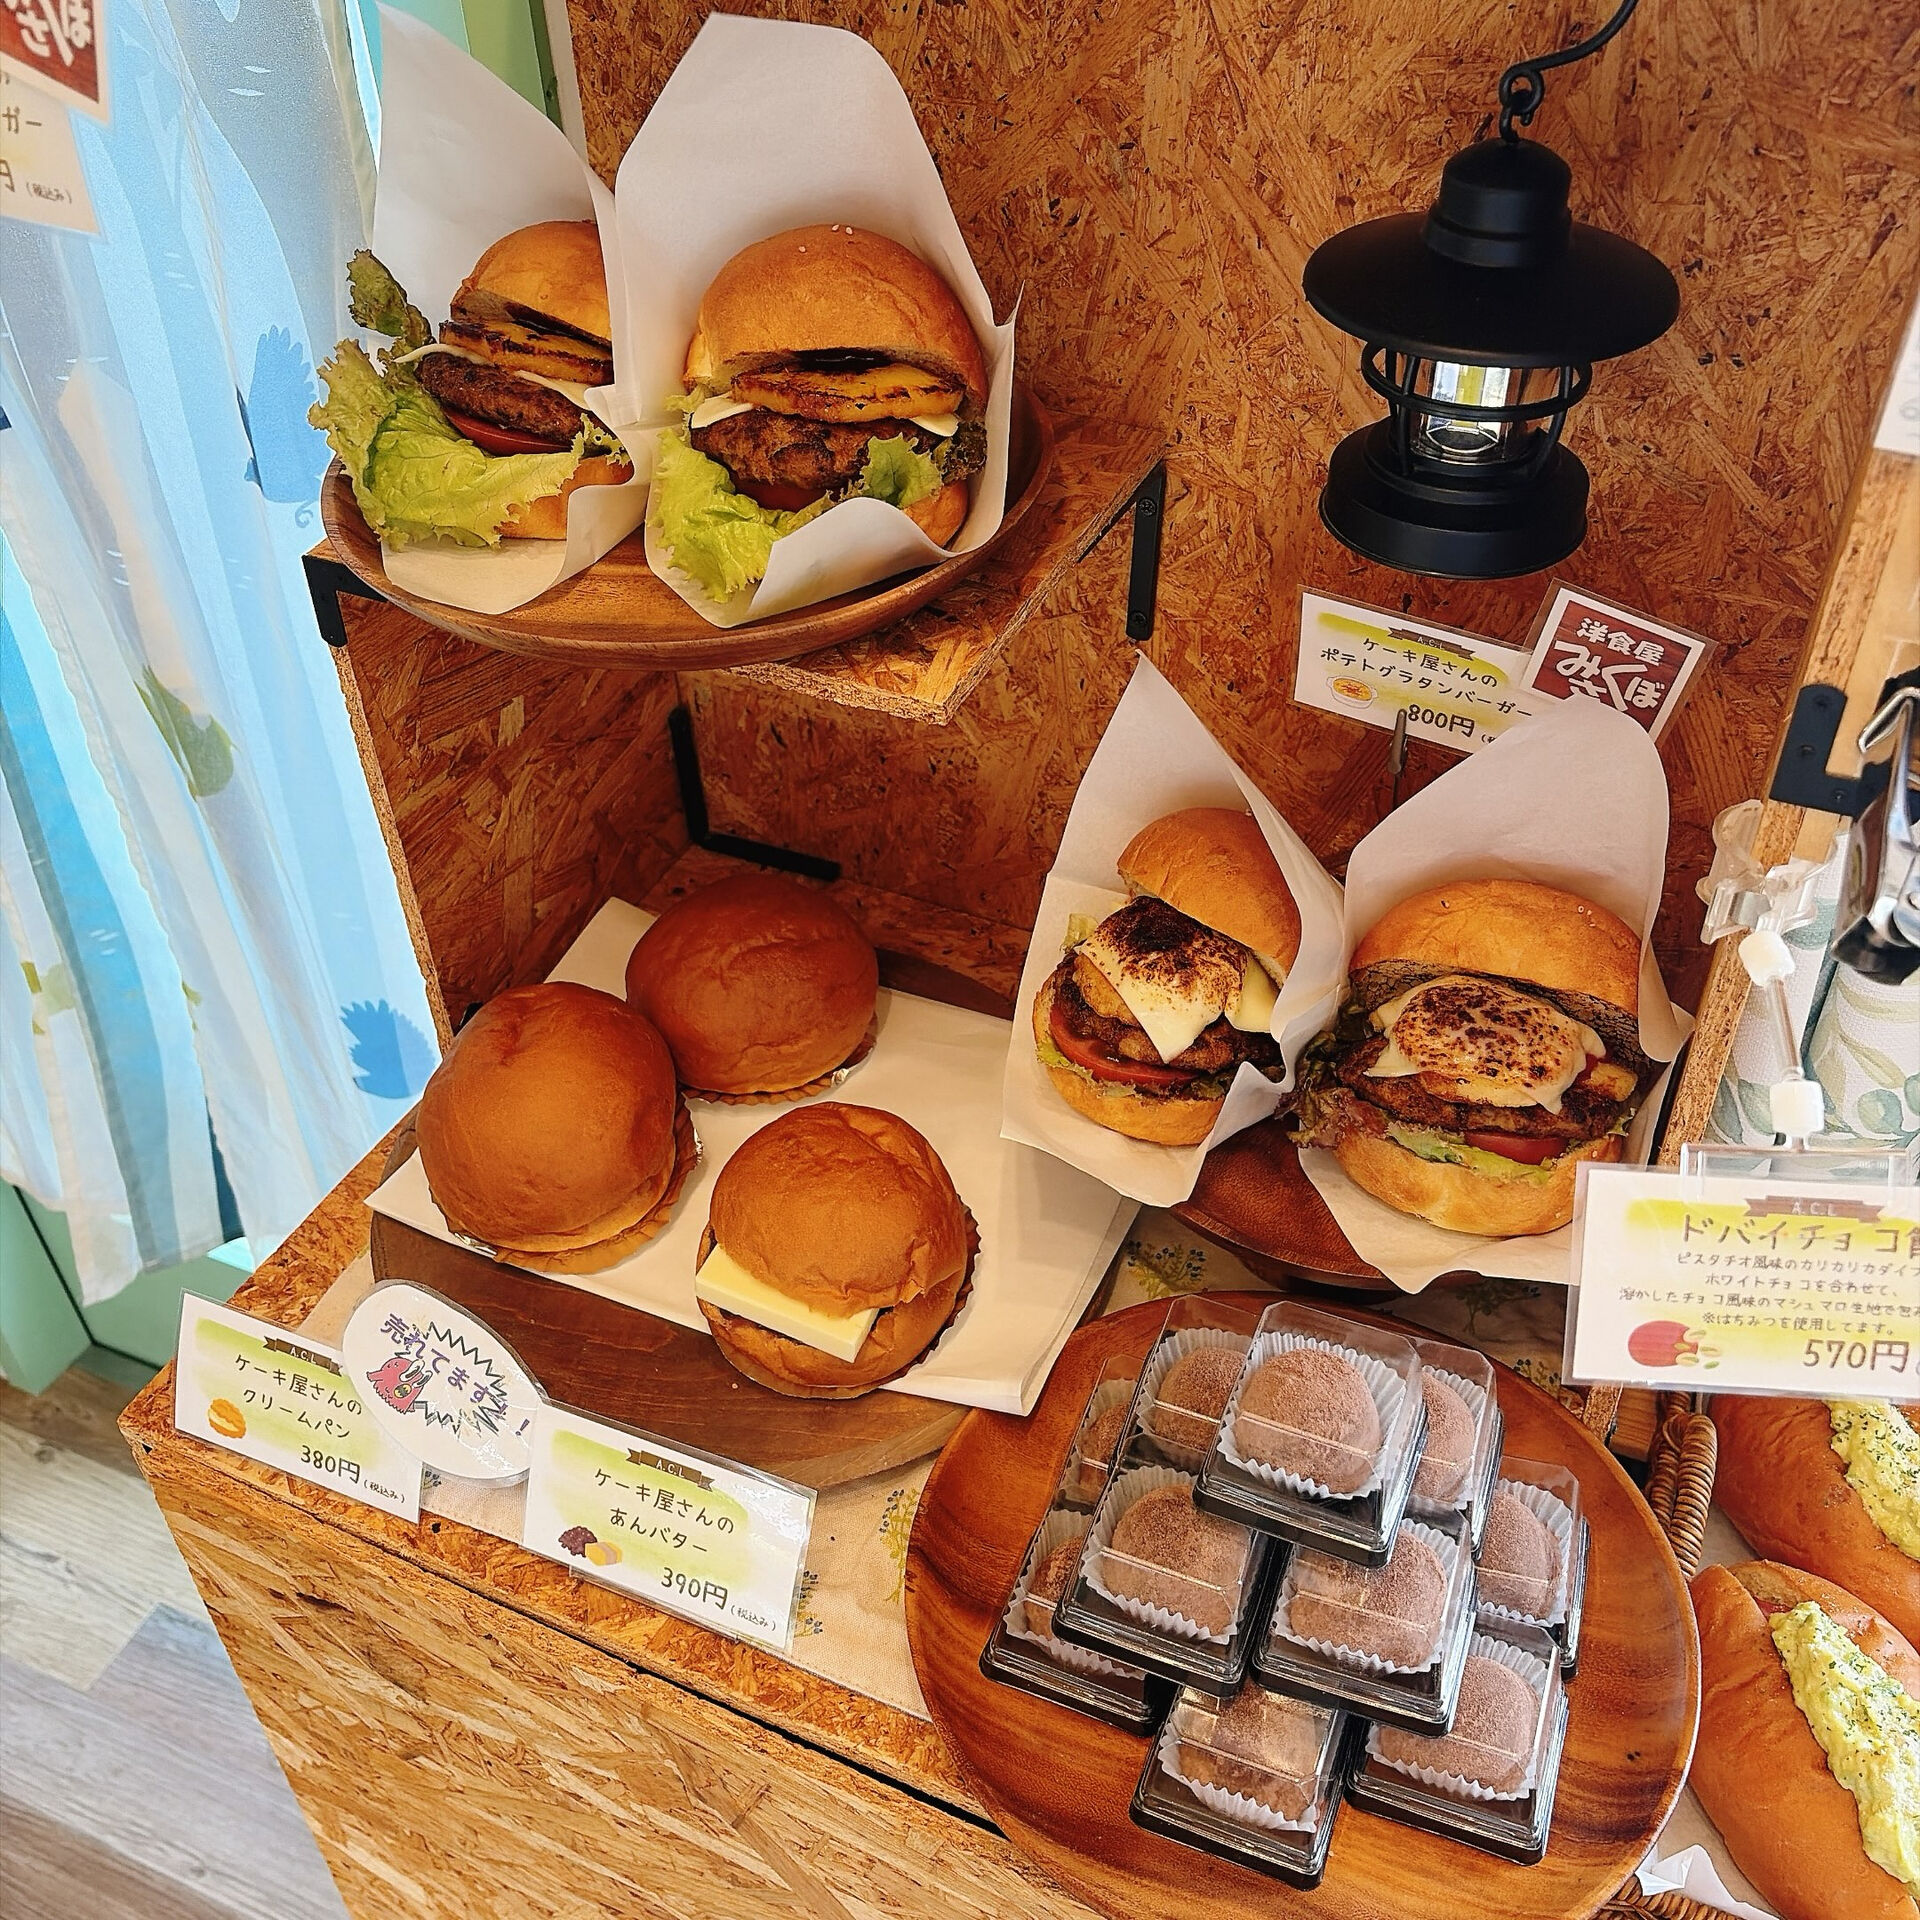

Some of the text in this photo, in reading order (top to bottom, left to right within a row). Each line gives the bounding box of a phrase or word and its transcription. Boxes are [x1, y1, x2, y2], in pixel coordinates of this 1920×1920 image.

[1363, 637, 1498, 688] ケーキ屋さんの
[1576, 617, 1665, 666] 洋食屋
[1320, 647, 1533, 717] ポテトグラタンバーガー
[1407, 704, 1475, 738] 800円
[1792, 1201, 1837, 1216] A.C.L
[1705, 1273, 1897, 1297] ホワイトチョコを合わせて、
[290, 1347, 319, 1366] A.C.L
[1803, 1339, 1910, 1374] 570円
[235, 1354, 362, 1416] ケーキ屋さんの
[242, 1388, 351, 1440] クリームパン
[299, 1444, 361, 1484] 380円
[656, 1458, 685, 1478] A.C.L
[594, 1467, 735, 1535] ケーキ屋さんの
[609, 1507, 708, 1552] あんバター
[660, 1567, 729, 1610] 390円
